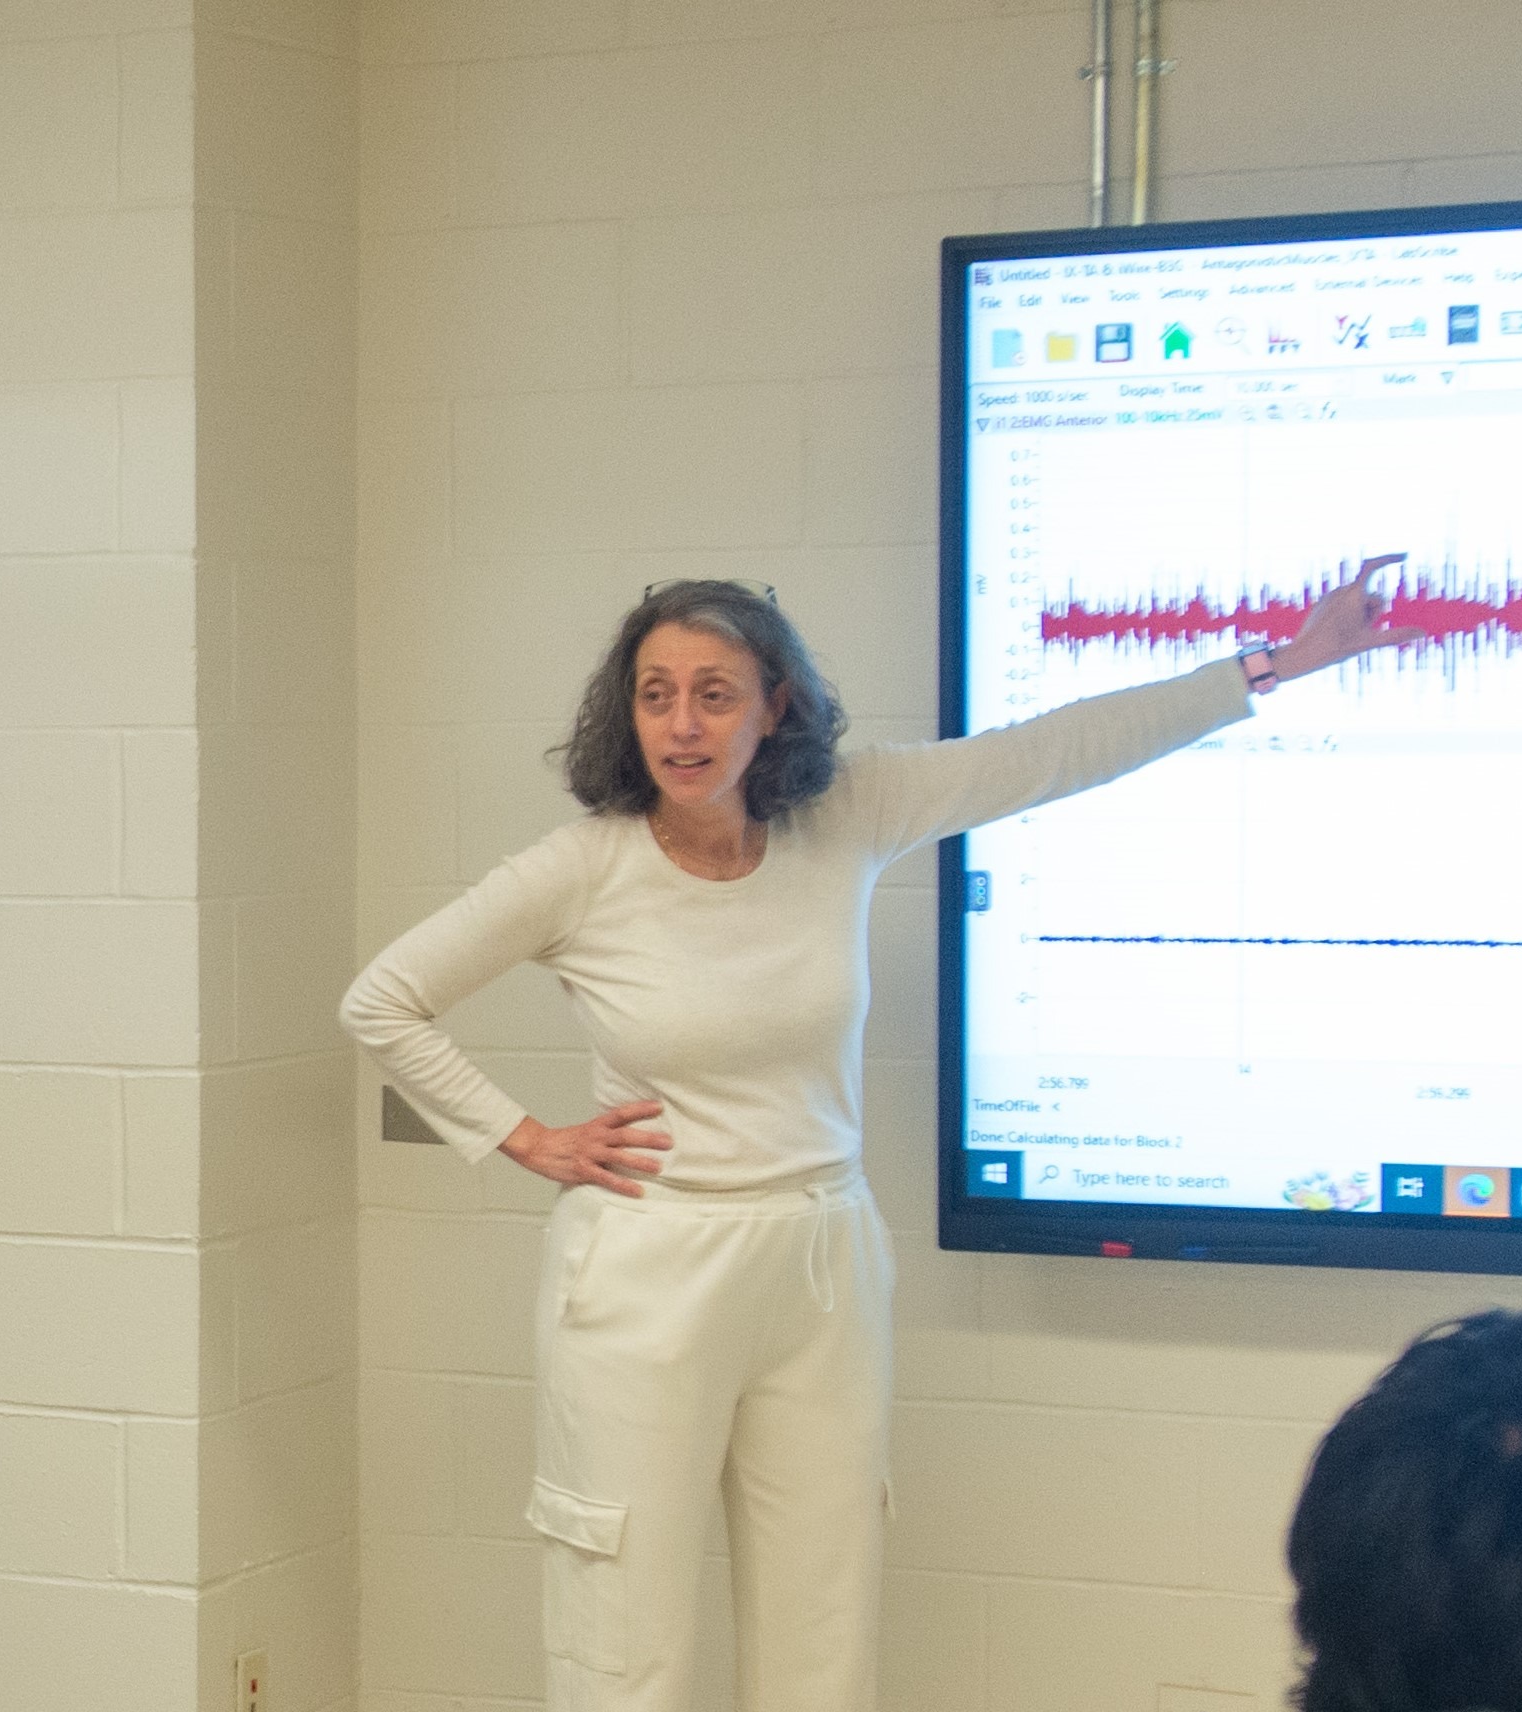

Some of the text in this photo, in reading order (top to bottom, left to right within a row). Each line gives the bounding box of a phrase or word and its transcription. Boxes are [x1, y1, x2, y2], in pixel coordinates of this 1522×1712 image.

[1001, 267, 1050, 282] Untitled
[1025, 389, 1053, 405] 1000
[1119, 381, 1205, 400] Display Time
[1056, 409, 1108, 427] Anterior
[972, 1098, 1042, 1114] TimeOfFile
[970, 1129, 1004, 1146] Done
[1007, 1130, 1079, 1151] Calculating
[1082, 1132, 1112, 1148] data
[1113, 1132, 1134, 1148] for
[1136, 1133, 1172, 1150] Block
[1072, 1167, 1230, 1193] Type here to search
